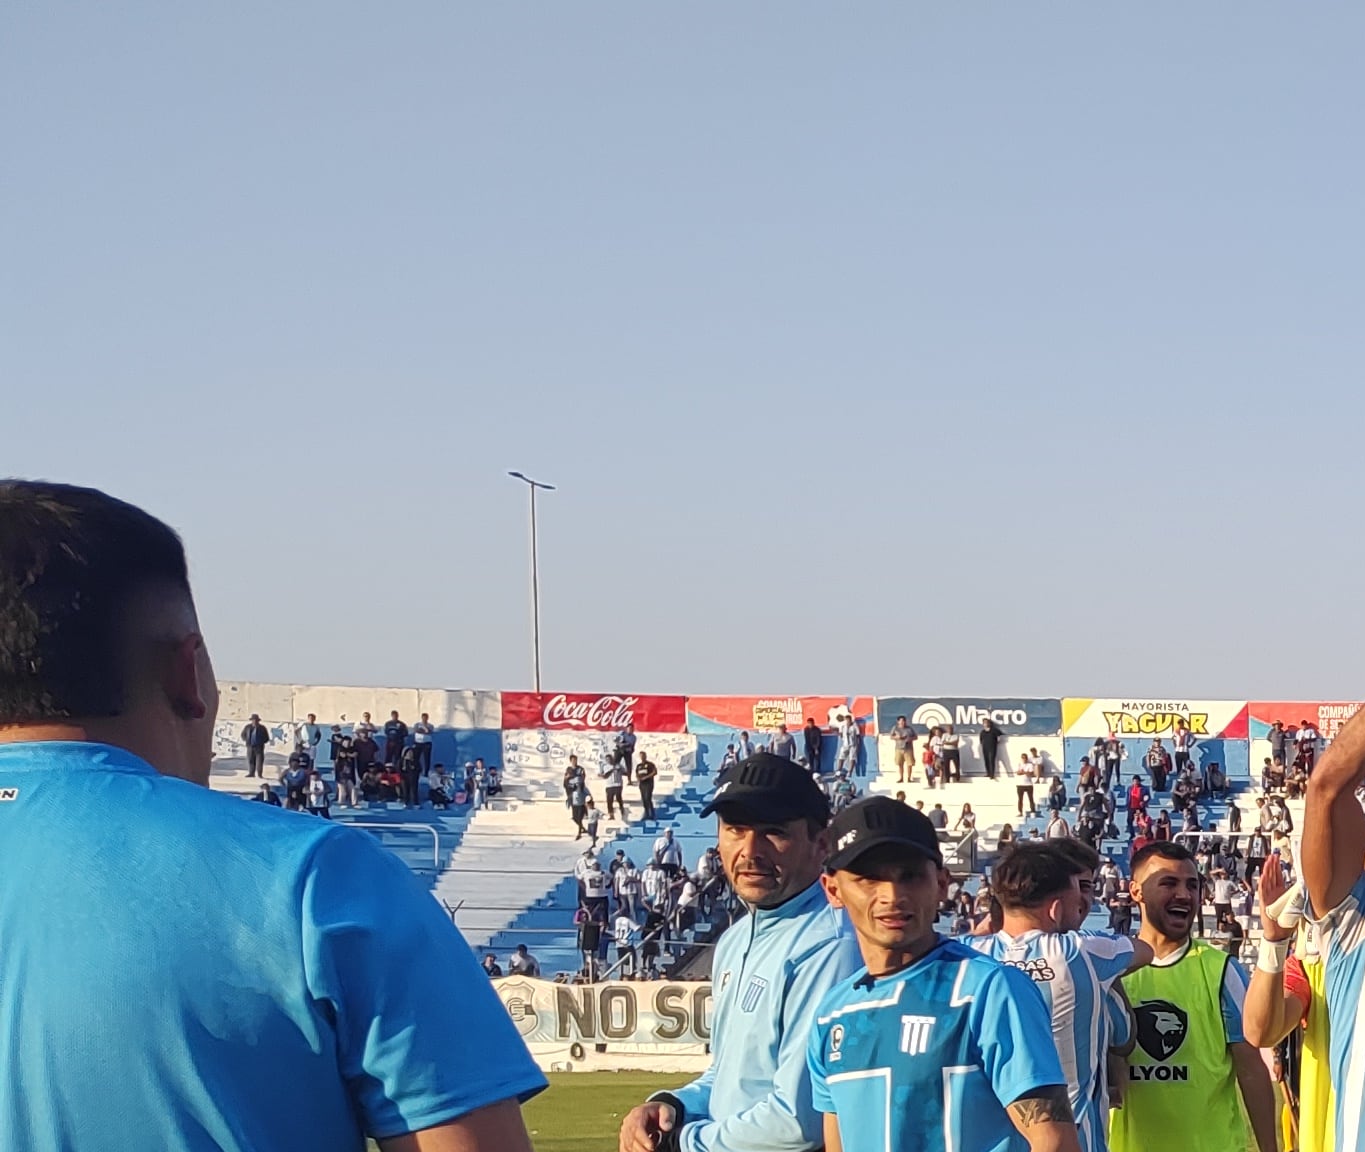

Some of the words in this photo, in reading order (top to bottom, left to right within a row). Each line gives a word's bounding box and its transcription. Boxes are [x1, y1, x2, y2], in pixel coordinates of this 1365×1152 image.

[956, 704, 1027, 726] Macro
[1121, 702, 1189, 712] MAYORISTA
[556, 985, 638, 1040] NO
[1128, 1065, 1189, 1081] LYON
